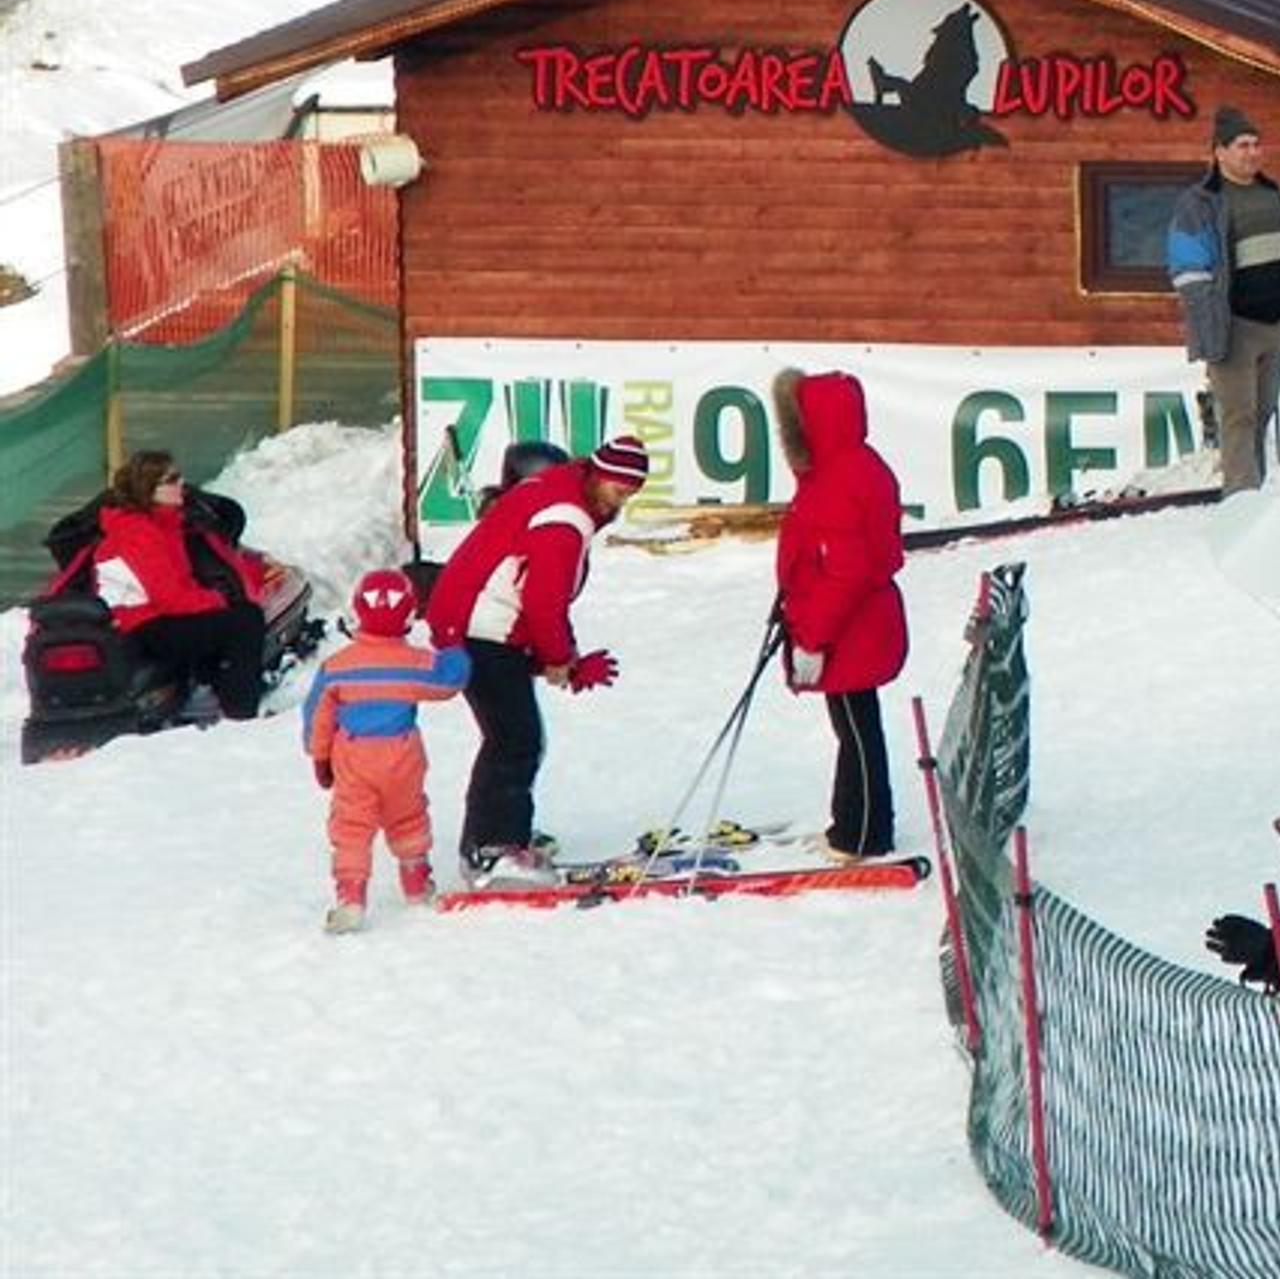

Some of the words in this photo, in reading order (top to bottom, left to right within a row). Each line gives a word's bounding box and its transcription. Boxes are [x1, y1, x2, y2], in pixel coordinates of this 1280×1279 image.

[518, 46, 854, 114] TRECATOAREA
[993, 56, 1192, 117] LUPILOR
[693, 384, 1196, 520] 9.6F
